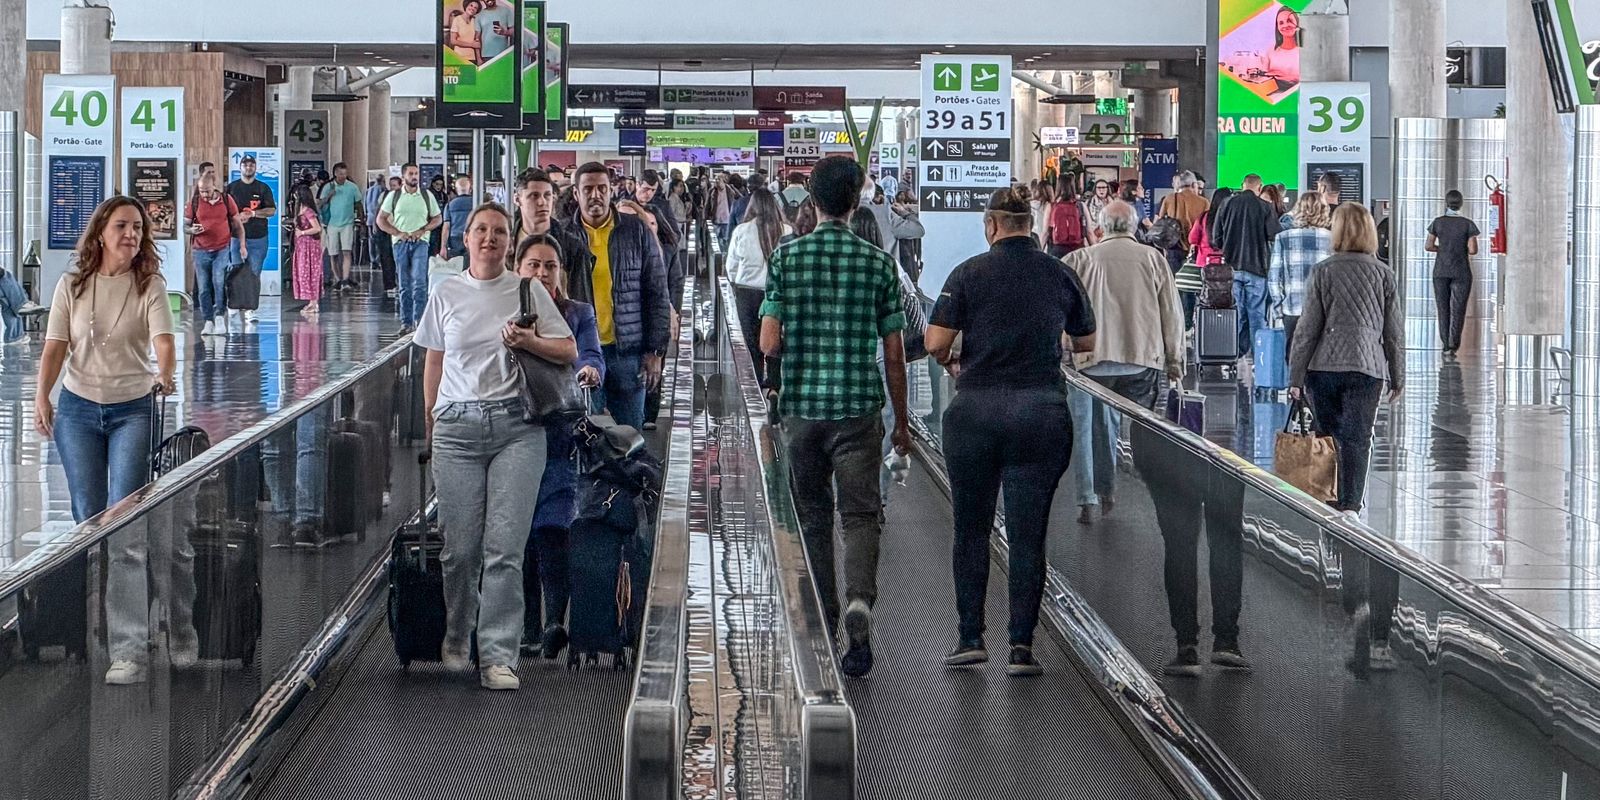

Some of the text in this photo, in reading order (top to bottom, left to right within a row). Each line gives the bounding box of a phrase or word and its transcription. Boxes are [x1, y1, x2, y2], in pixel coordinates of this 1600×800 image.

[934, 95, 1001, 105] Portões Gates
[50, 90, 108, 127] 40
[1307, 96, 1365, 133] 39
[130, 99, 176, 132] 41
[926, 110, 1006, 130] 39 a 51
[289, 119, 325, 142] 43
[1239, 117, 1286, 134] QUEM
[1085, 123, 1121, 144] 42
[53, 137, 80, 145] Portão
[419, 134, 445, 151] 45
[971, 142, 986, 150] Sala
[786, 145, 799, 154] 44
[808, 145, 819, 155] 51
[881, 147, 899, 159] 50
[907, 144, 916, 157] 4
[1311, 144, 1338, 152] Portão
[1144, 153, 1176, 164] ATM
[965, 170, 1007, 178] Alimentação
[971, 164, 990, 172] Praça
